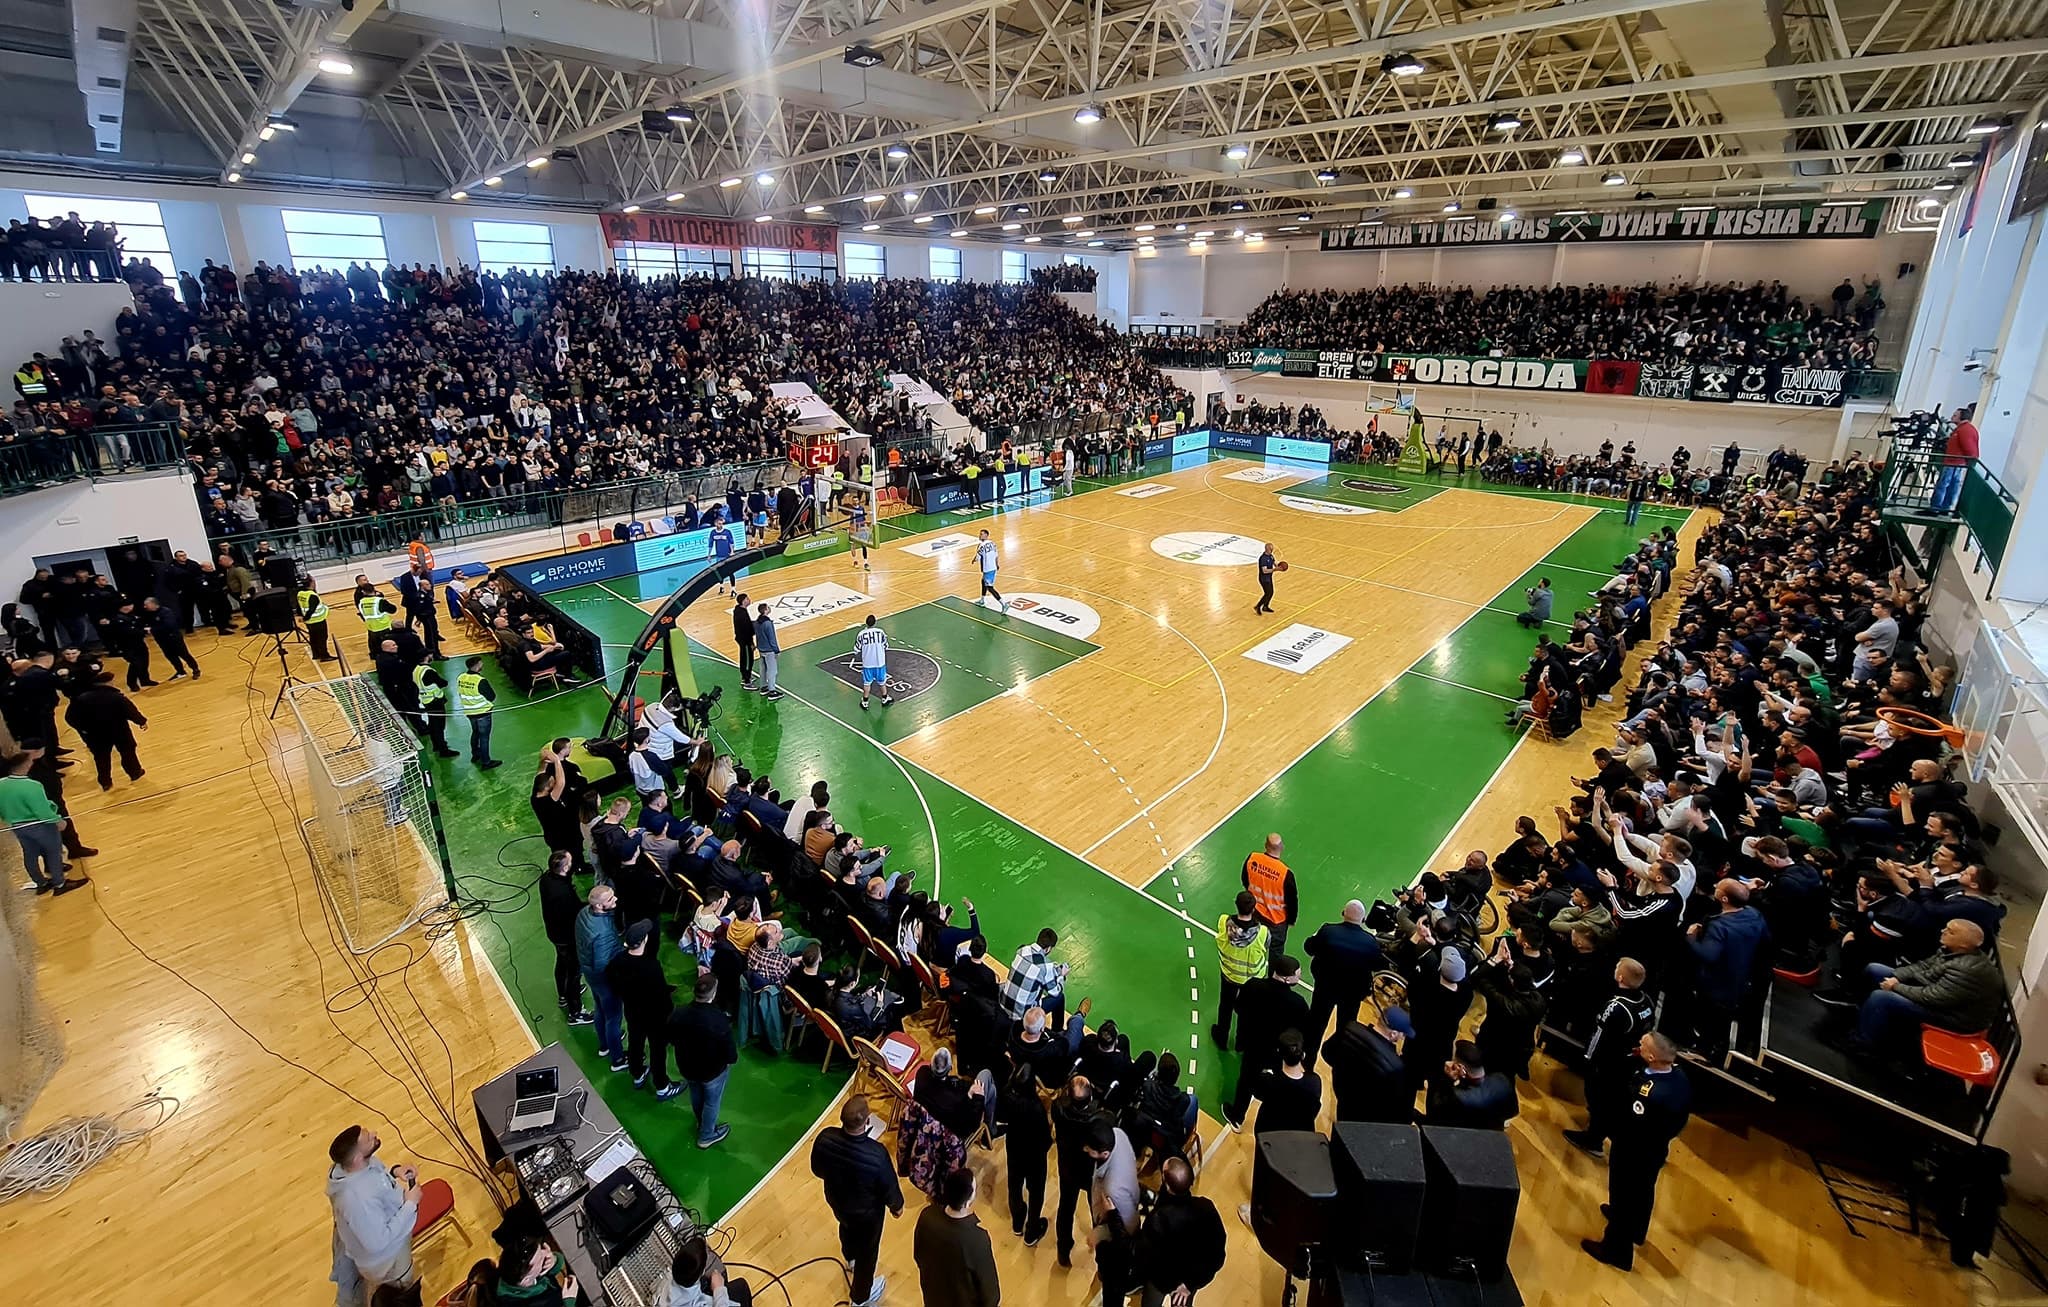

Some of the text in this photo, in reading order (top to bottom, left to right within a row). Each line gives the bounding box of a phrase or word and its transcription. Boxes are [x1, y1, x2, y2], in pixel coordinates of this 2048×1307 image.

[1600, 205, 1867, 238] DYJAT TI KISHA FAL
[650, 218, 805, 249] AUTOCHTHONOUS
[1328, 217, 1550, 247] DY ZEMRA TI KISHA PAS
[1227, 351, 1253, 364] 1312
[1319, 352, 1353, 362] GREEN
[1781, 367, 1846, 391] TAVNIK
[1774, 389, 1840, 405] CITY
[817, 432, 838, 446] 1:44
[812, 447, 833, 465] 24
[548, 557, 606, 577] BP HOME
[549, 565, 606, 582] INVESTMENT
[774, 594, 863, 625] ERASAN
[1033, 607, 1081, 625] BPB
[1292, 631, 1325, 651] GRAND
